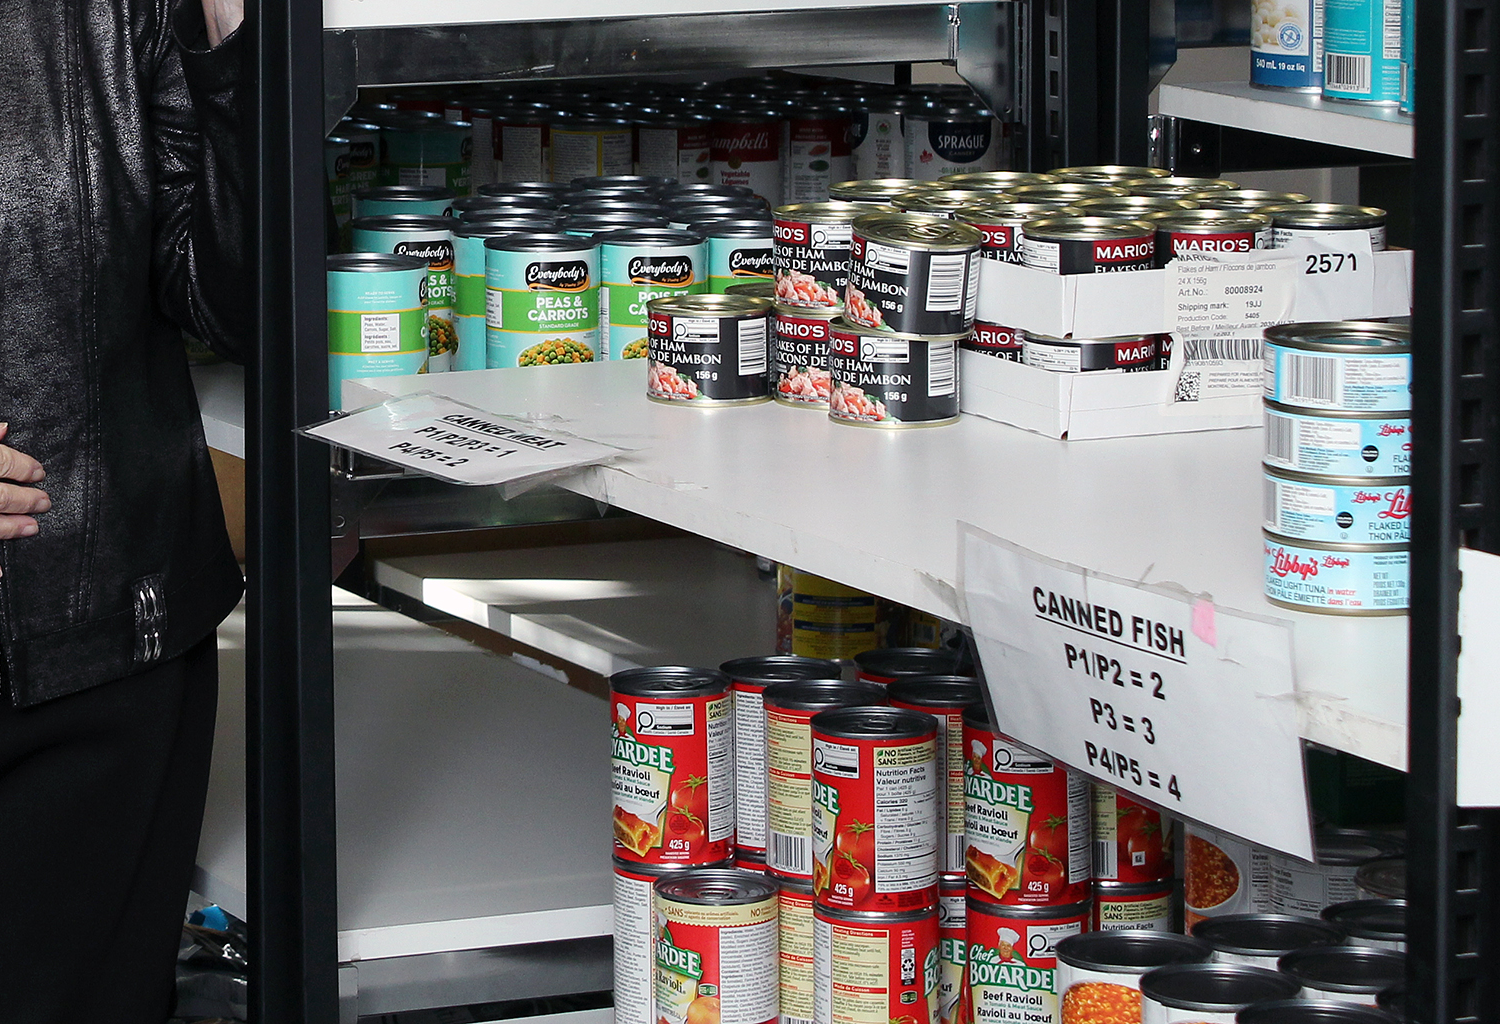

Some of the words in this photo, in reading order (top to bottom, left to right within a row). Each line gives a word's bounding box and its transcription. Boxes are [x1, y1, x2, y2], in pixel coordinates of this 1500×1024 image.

[1256, 58, 1265, 68] 540
[1266, 59, 1277, 69] mL
[1278, 62, 1286, 70] 19
[1296, 62, 1306, 72] liq
[938, 134, 985, 150] SPRAGUE
[720, 171, 750, 179] Vegetable
[1096, 241, 1155, 259] MARIO'S
[1173, 239, 1250, 253] MARIO'S
[782, 248, 793, 259] OF
[796, 248, 825, 260] HAM
[630, 260, 689, 276] Everybody's
[853, 262, 875, 279] HAM
[1178, 265, 1197, 273] Flakes
[1254, 263, 1276, 271] jambon
[1305, 253, 1358, 275] 2571
[527, 265, 586, 282] Everybody's
[851, 276, 860, 286] DE
[861, 276, 909, 297] JAMBON
[1193, 277, 1207, 286] 156g
[536, 296, 571, 309] PEAS
[573, 295, 583, 307] &
[881, 300, 896, 311] 156
[896, 304, 903, 313] g
[1178, 303, 1208, 312] Shipping
[1209, 302, 1229, 310] mark:
[1245, 300, 1262, 308] 19JJ
[527, 307, 588, 321] CARROTS
[658, 352, 670, 362] DE
[672, 352, 722, 366] JAMBON
[835, 359, 844, 370] OF
[846, 360, 873, 373] HAM
[695, 370, 710, 380] 156
[711, 372, 718, 381] g
[844, 372, 856, 385] DE
[858, 373, 911, 387] JAMBON
[884, 392, 899, 402] 156
[900, 393, 907, 403] g
[442, 413, 513, 436] CANNED
[512, 432, 567, 449] MEAT
[415, 426, 490, 451] P1/P2/P3
[498, 449, 517, 458] 1
[389, 442, 440, 461] P4/P5
[437, 455, 450, 463] =
[446, 458, 470, 467] 2
[1351, 491, 1381, 503] Libby's
[1369, 522, 1401, 530] FLAKED
[1269, 547, 1318, 580] Libby's
[1320, 555, 1350, 568] Libby's
[1266, 575, 1282, 587] FLAKED
[1283, 578, 1302, 590] LIGHT
[1304, 582, 1326, 594] TUNA
[1032, 586, 1124, 638] CANNED
[1131, 615, 1185, 657] FISH
[1064, 643, 1124, 687] P1/P2
[1130, 670, 1143, 688] =
[1151, 671, 1166, 700] 2
[714, 702, 722, 710] NO
[1089, 697, 1118, 731] P3
[1122, 715, 1135, 733] =
[1141, 717, 1156, 745] 3
[612, 738, 675, 772] YARDEE
[876, 769, 907, 778] Nutrition
[909, 766, 925, 775] Facts
[1085, 740, 1142, 786] P4/P5
[1148, 771, 1161, 789] =
[1168, 774, 1181, 801] 4
[876, 777, 900, 786] Valeur
[901, 775, 926, 784] nutritive
[669, 840, 683, 849] 425
[685, 842, 690, 850] g
[835, 883, 847, 894] 425
[848, 888, 853, 897] g
[1028, 882, 1042, 892] 425
[1044, 883, 1049, 893] g
[667, 907, 684, 917] SANS
[751, 908, 760, 917] NO
[1110, 904, 1122, 912] NO
[969, 944, 994, 962] Chef
[970, 960, 1056, 992] BOYARDE
[983, 990, 1003, 1002] Beef
[1006, 992, 1043, 1006] Ravioli
[977, 1007, 1006, 1020] Ravioli
[1008, 1011, 1021, 1019] au
[1024, 1008, 1052, 1023] bœuf
